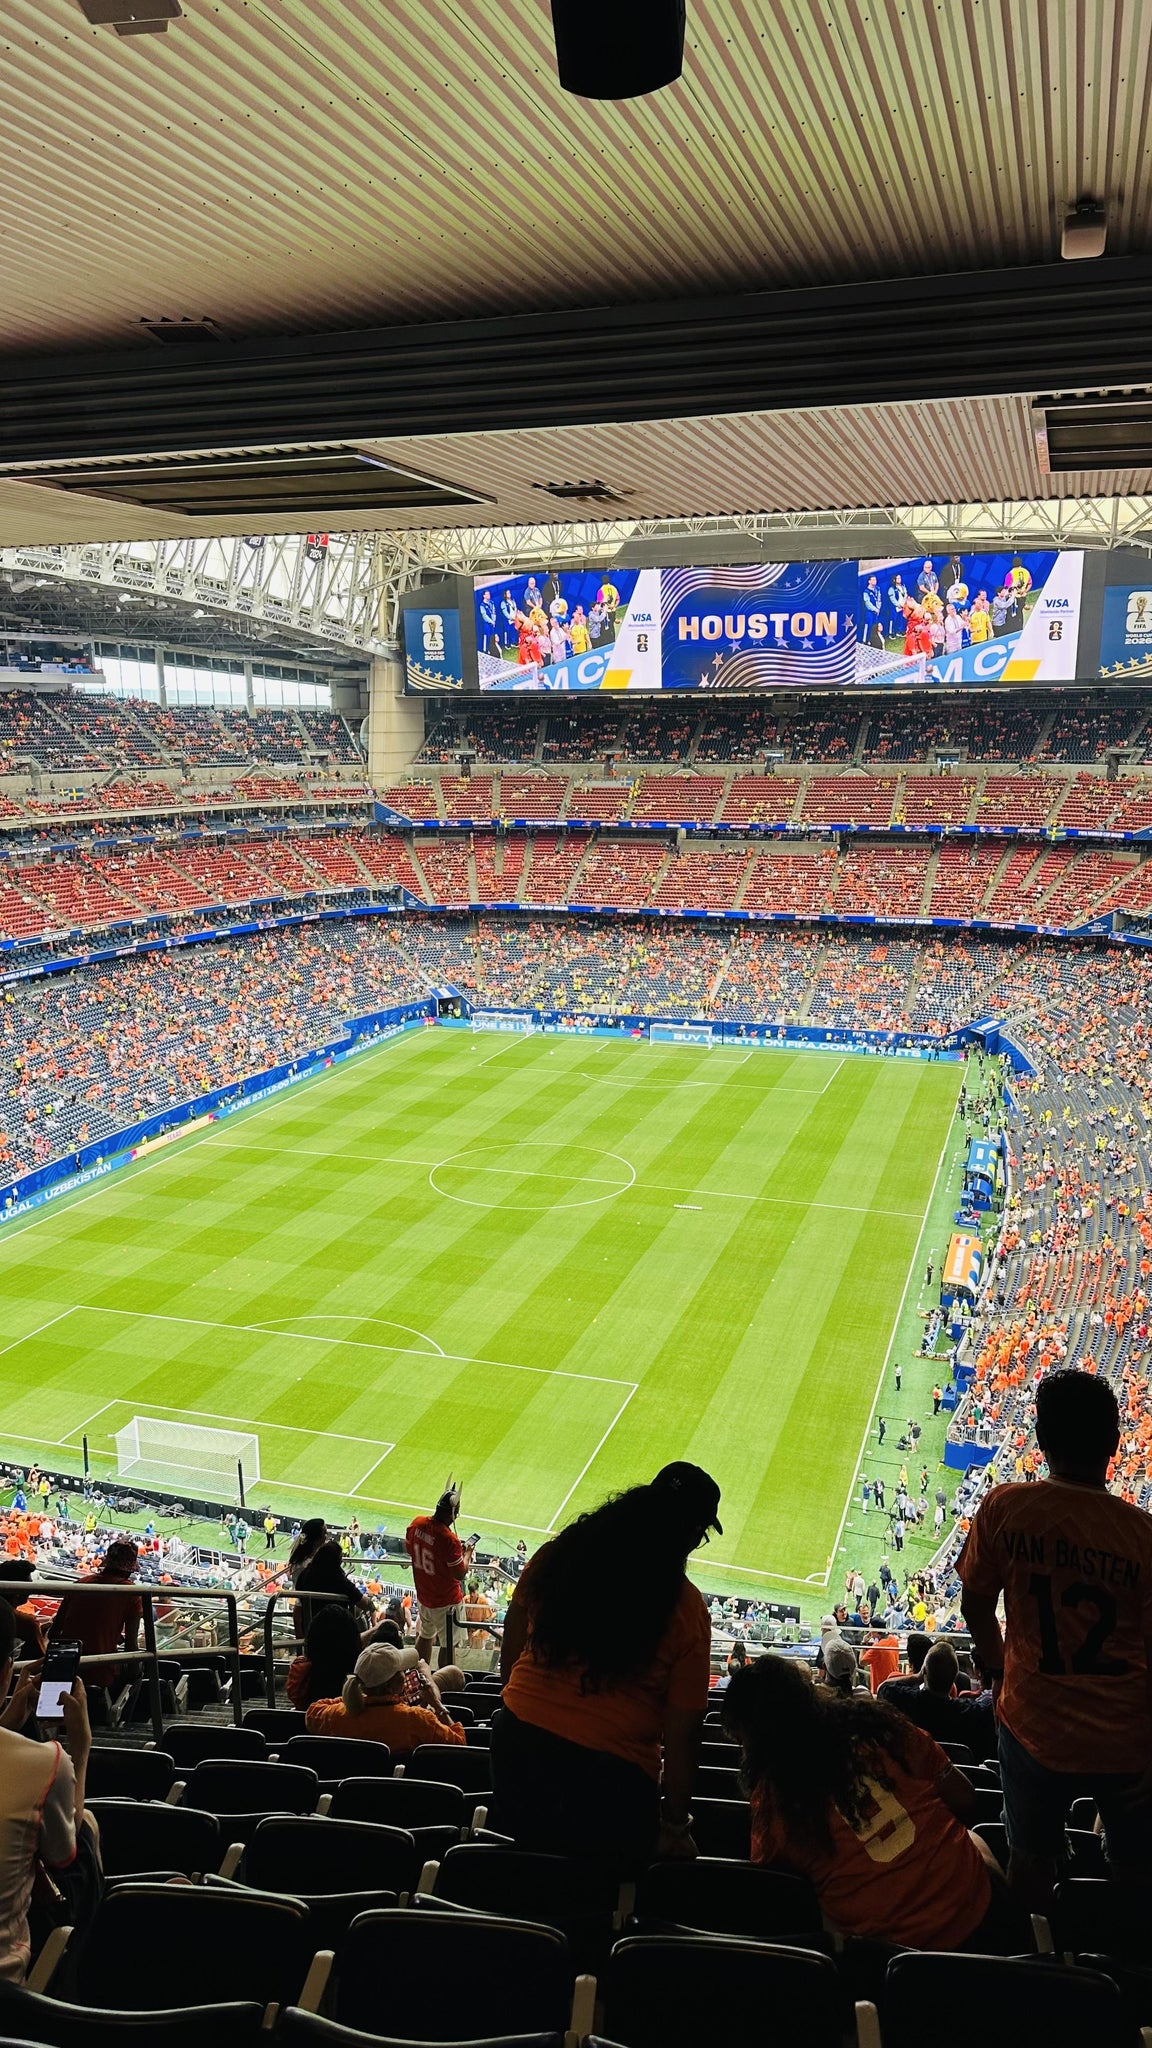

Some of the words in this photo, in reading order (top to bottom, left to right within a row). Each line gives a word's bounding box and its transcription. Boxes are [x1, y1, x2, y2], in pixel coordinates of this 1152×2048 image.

[1044, 599, 1069, 608] VISA
[631, 613, 652, 622] VISA
[678, 611, 838, 640] HOUSTON
[558, 1026, 577, 1034] PM
[852, 1031, 867, 1039] FIFA
[673, 1032, 702, 1041] BUY
[704, 1035, 760, 1047] TICKETS
[762, 1039, 784, 1048] ON
[227, 1096, 253, 1114] JUNE
[44, 1161, 113, 1200] UZBEKISTAN
[412, 1542, 437, 1577] 16
[1002, 1530, 1045, 1564] VAN
[1055, 1536, 1141, 1588] BASTEN
[1029, 1572, 1130, 1676] 12
